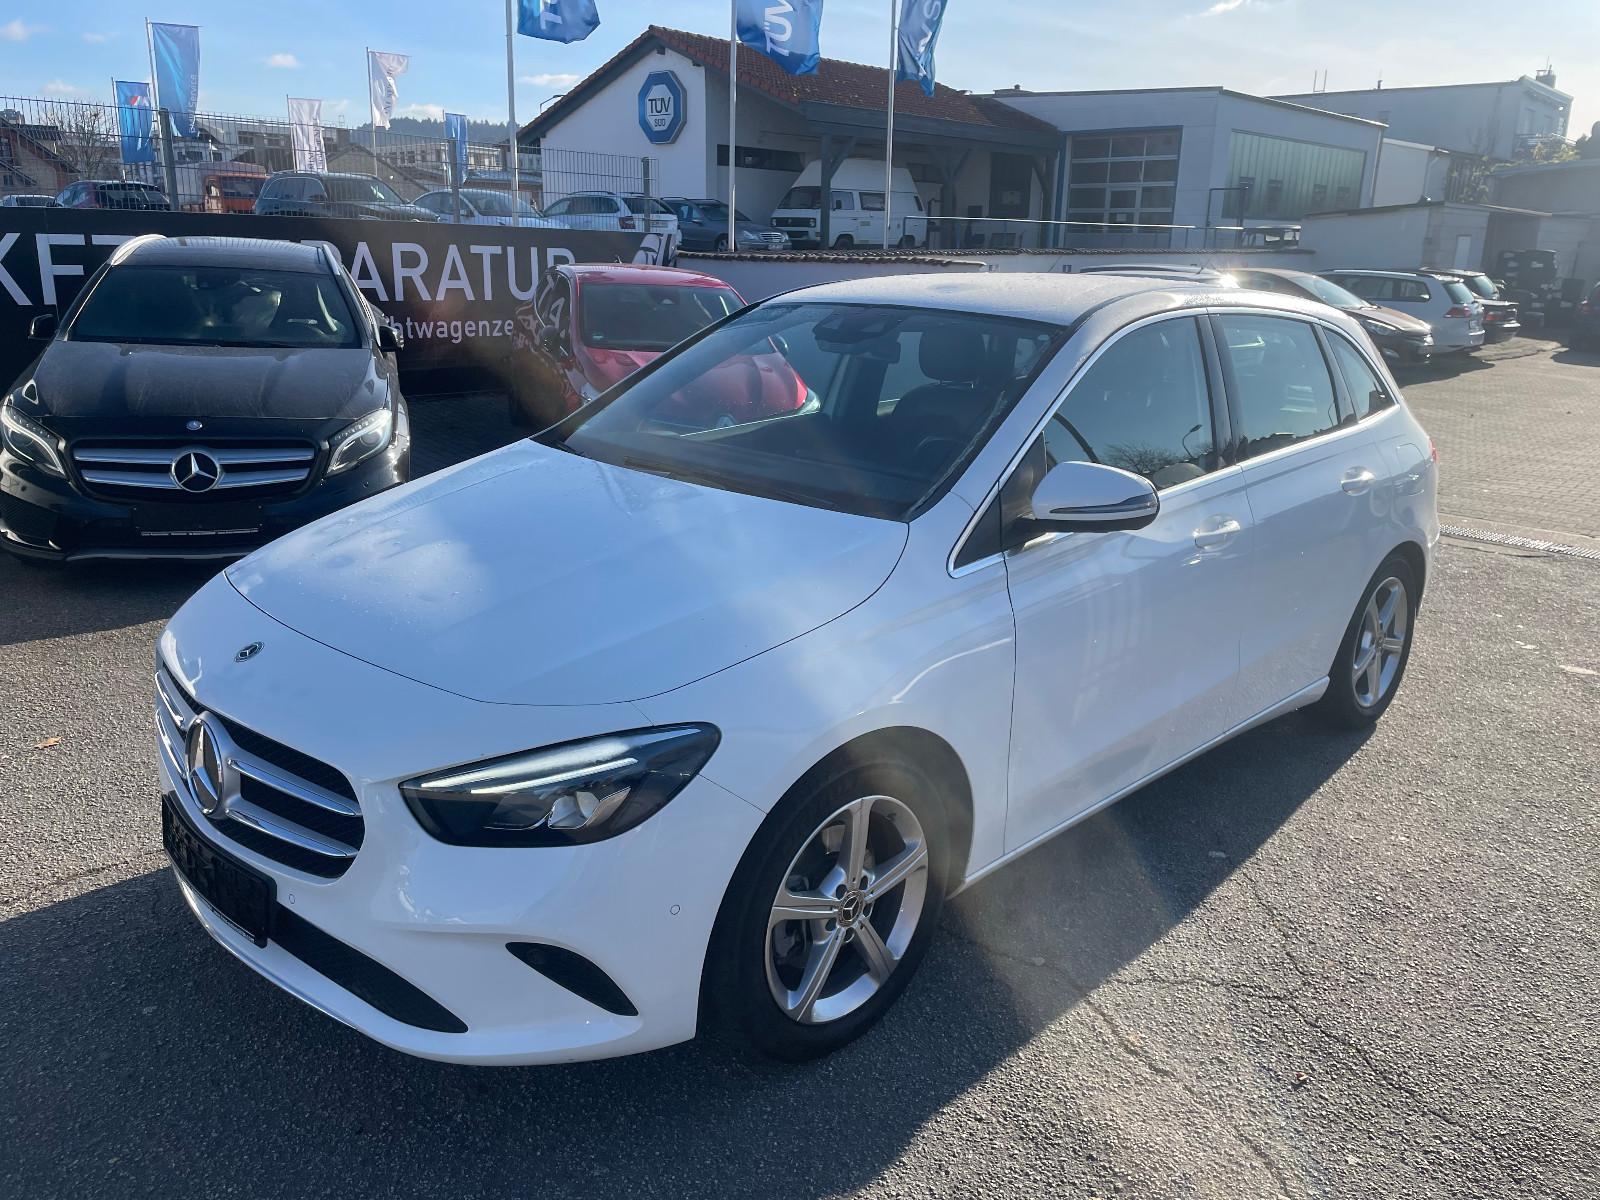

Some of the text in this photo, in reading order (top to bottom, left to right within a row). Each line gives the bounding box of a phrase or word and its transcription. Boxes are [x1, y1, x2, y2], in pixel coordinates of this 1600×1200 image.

[764, 0, 794, 57] TÜV
[647, 96, 672, 114] TÜV
[0, 232, 138, 306] KF
[384, 315, 514, 344] htwagenze
